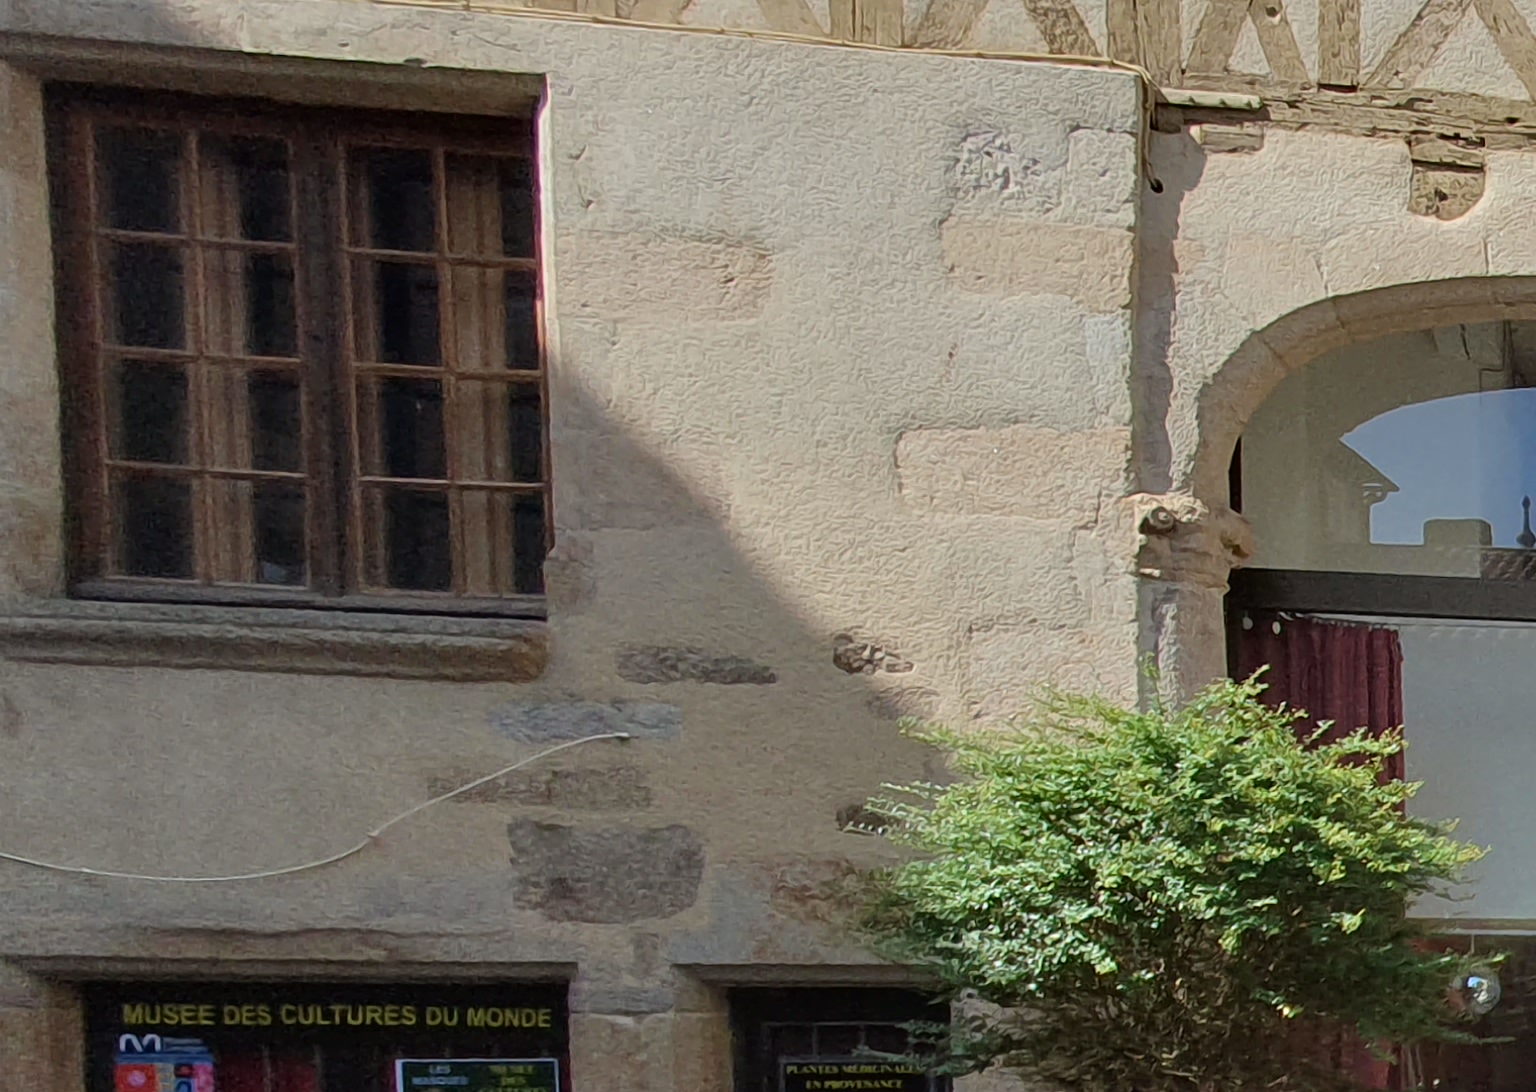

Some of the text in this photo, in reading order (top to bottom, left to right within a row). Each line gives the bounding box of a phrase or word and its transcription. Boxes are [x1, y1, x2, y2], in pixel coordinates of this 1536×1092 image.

[223, 1004, 272, 1027] DES
[280, 1004, 417, 1027] CULTURES
[425, 1005, 458, 1027] DU
[466, 1007, 551, 1029] MONDE
